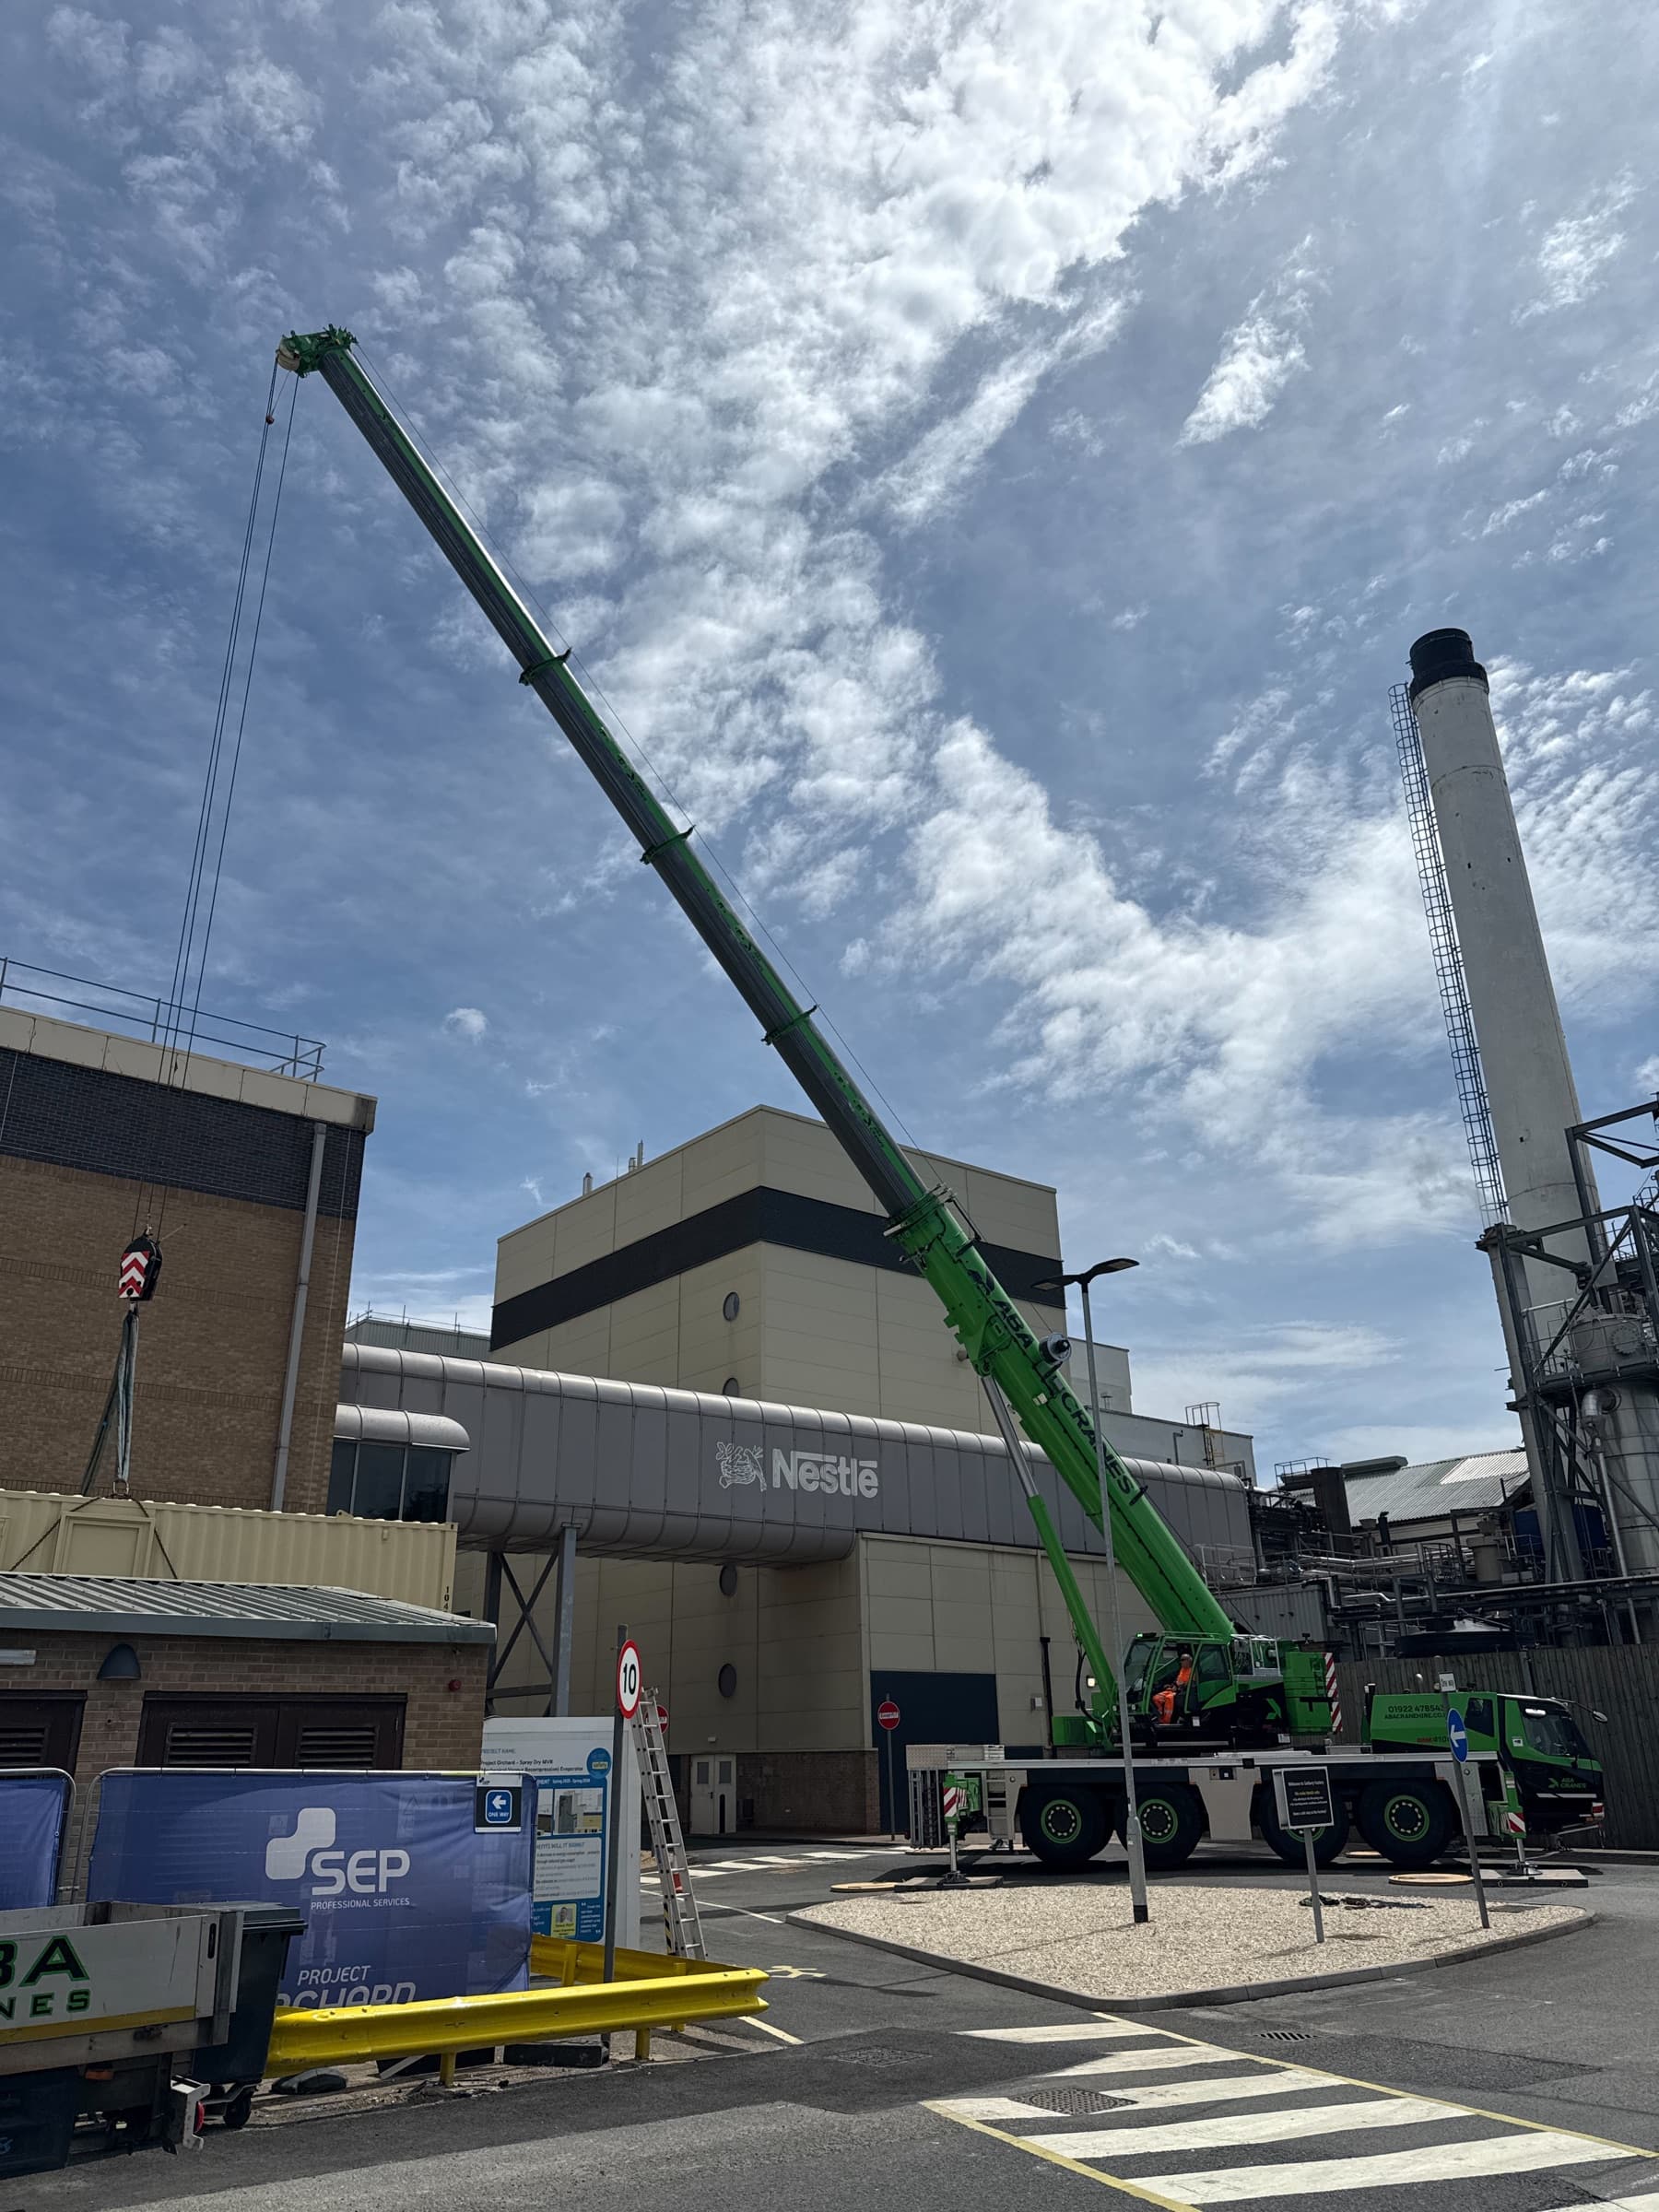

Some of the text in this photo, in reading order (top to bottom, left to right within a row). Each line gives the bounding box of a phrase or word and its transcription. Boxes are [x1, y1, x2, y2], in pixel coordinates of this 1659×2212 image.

[992, 1300, 1033, 1348] ABA
[623, 1663, 637, 1695] 10
[312, 1849, 411, 1896] SEP
[311, 1897, 410, 1911] PROFESSIONAL SERVICES
[298, 1965, 371, 1986] PROJECT
